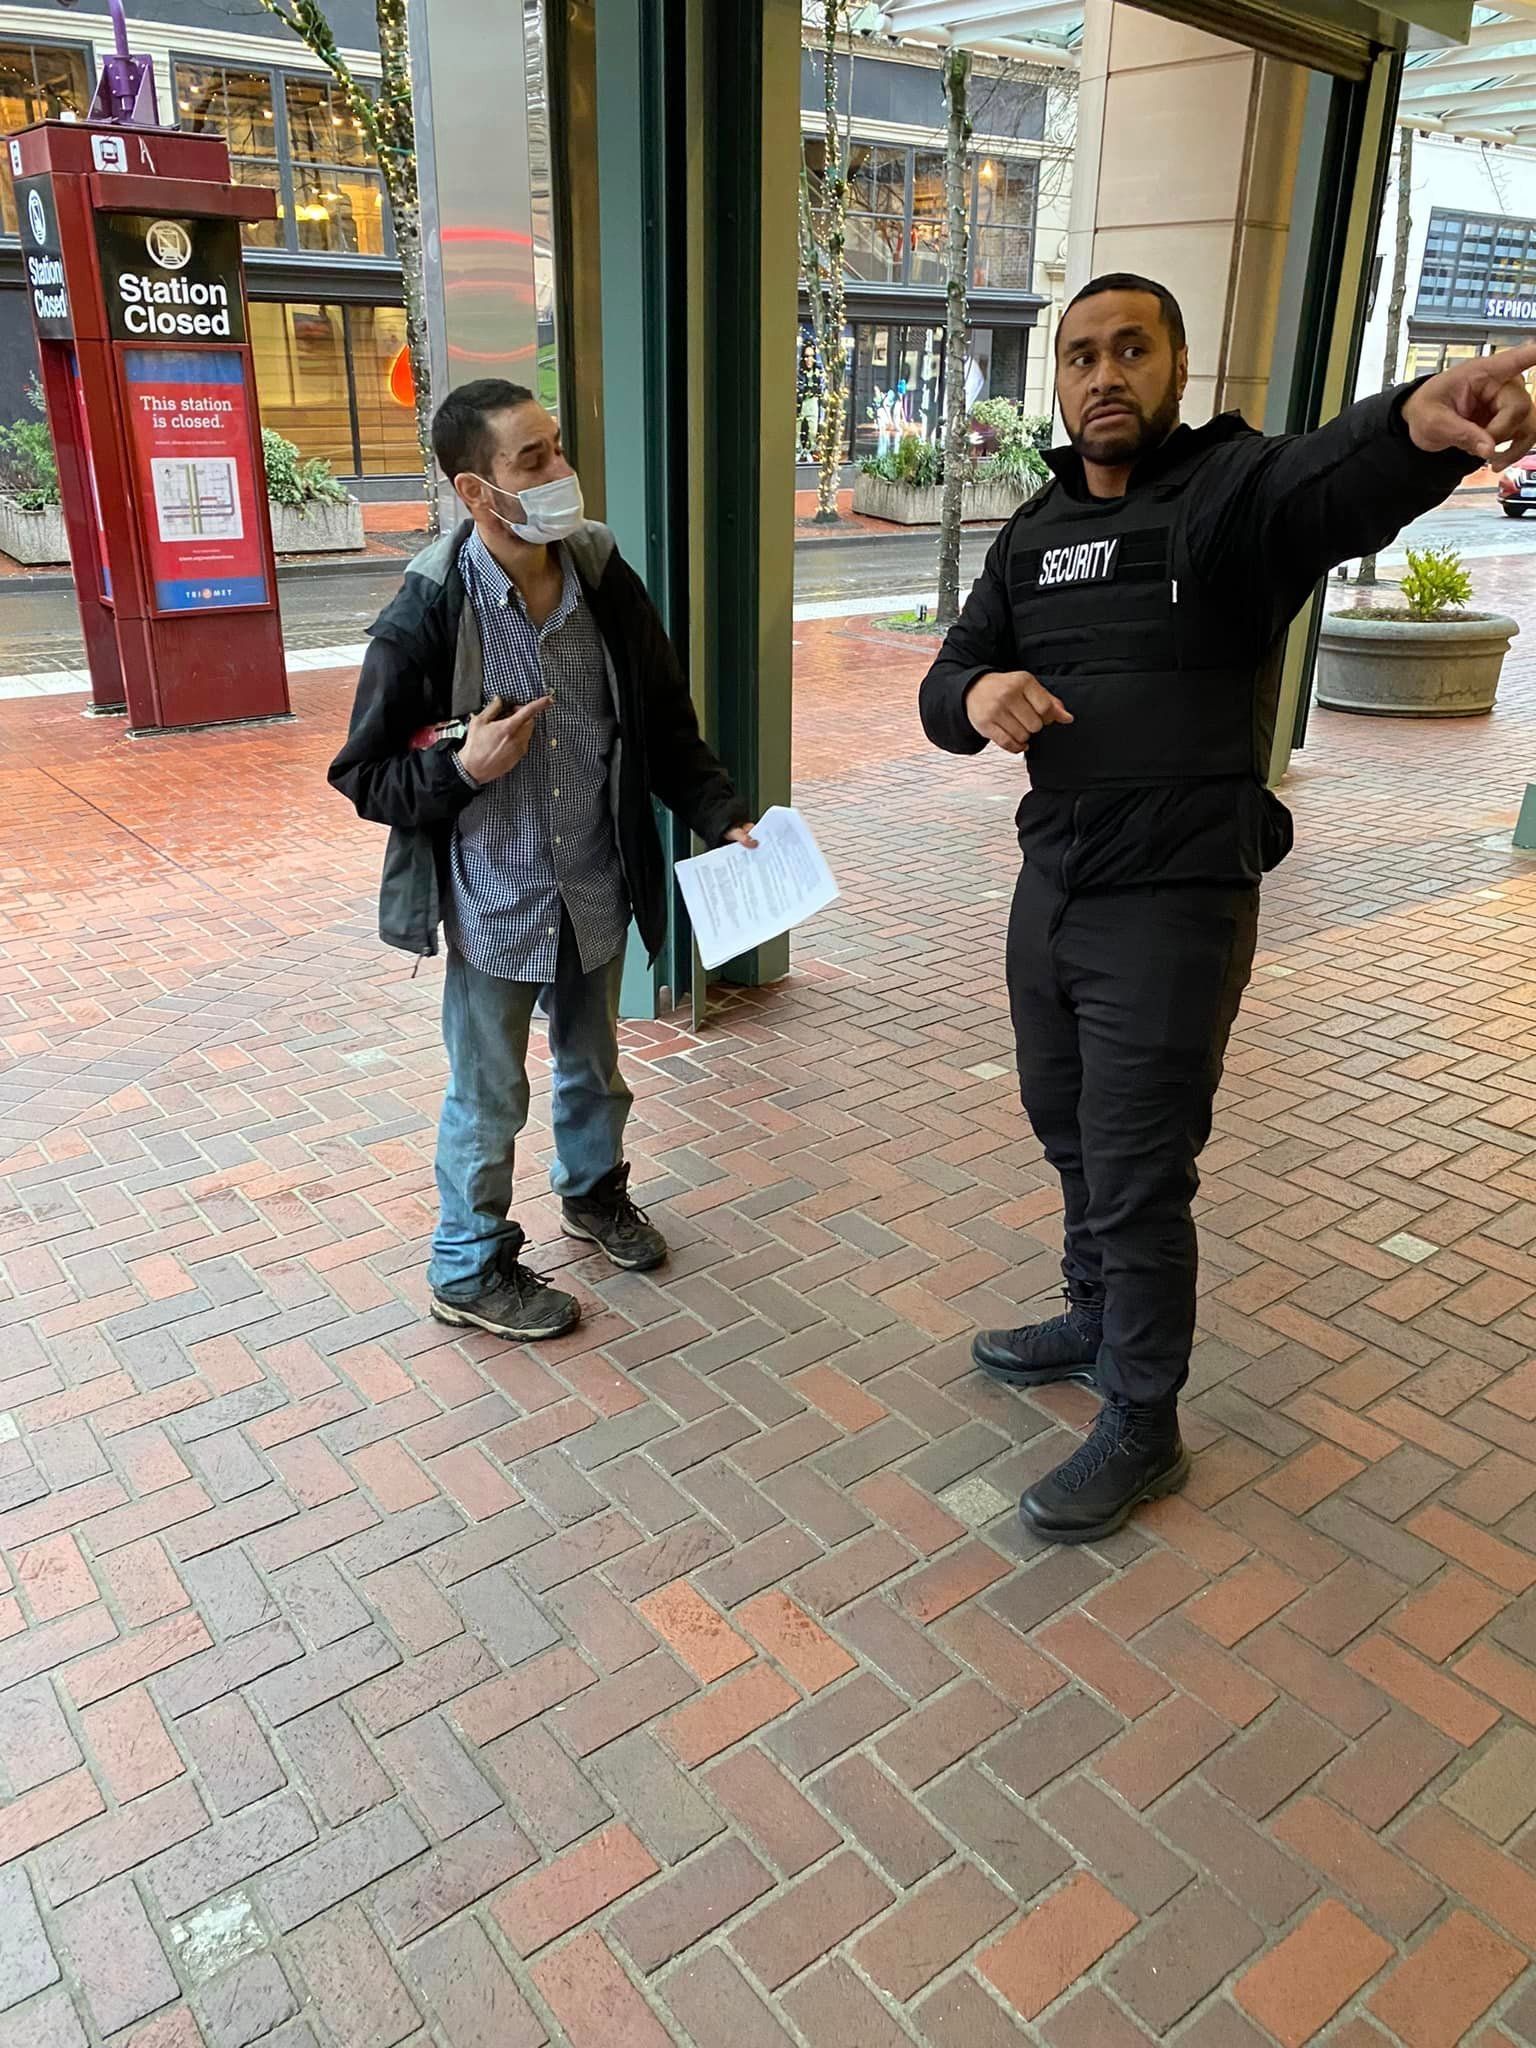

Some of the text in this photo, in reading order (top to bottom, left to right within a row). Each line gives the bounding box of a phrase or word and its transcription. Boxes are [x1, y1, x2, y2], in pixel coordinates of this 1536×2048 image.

[29, 256, 63, 285] Station
[34, 288, 67, 318] Closed
[118, 273, 228, 306] Station
[124, 304, 231, 336] Closed
[139, 395, 232, 412] This station
[153, 413, 225, 429] is closed.
[1039, 539, 1117, 585] SECURITY
